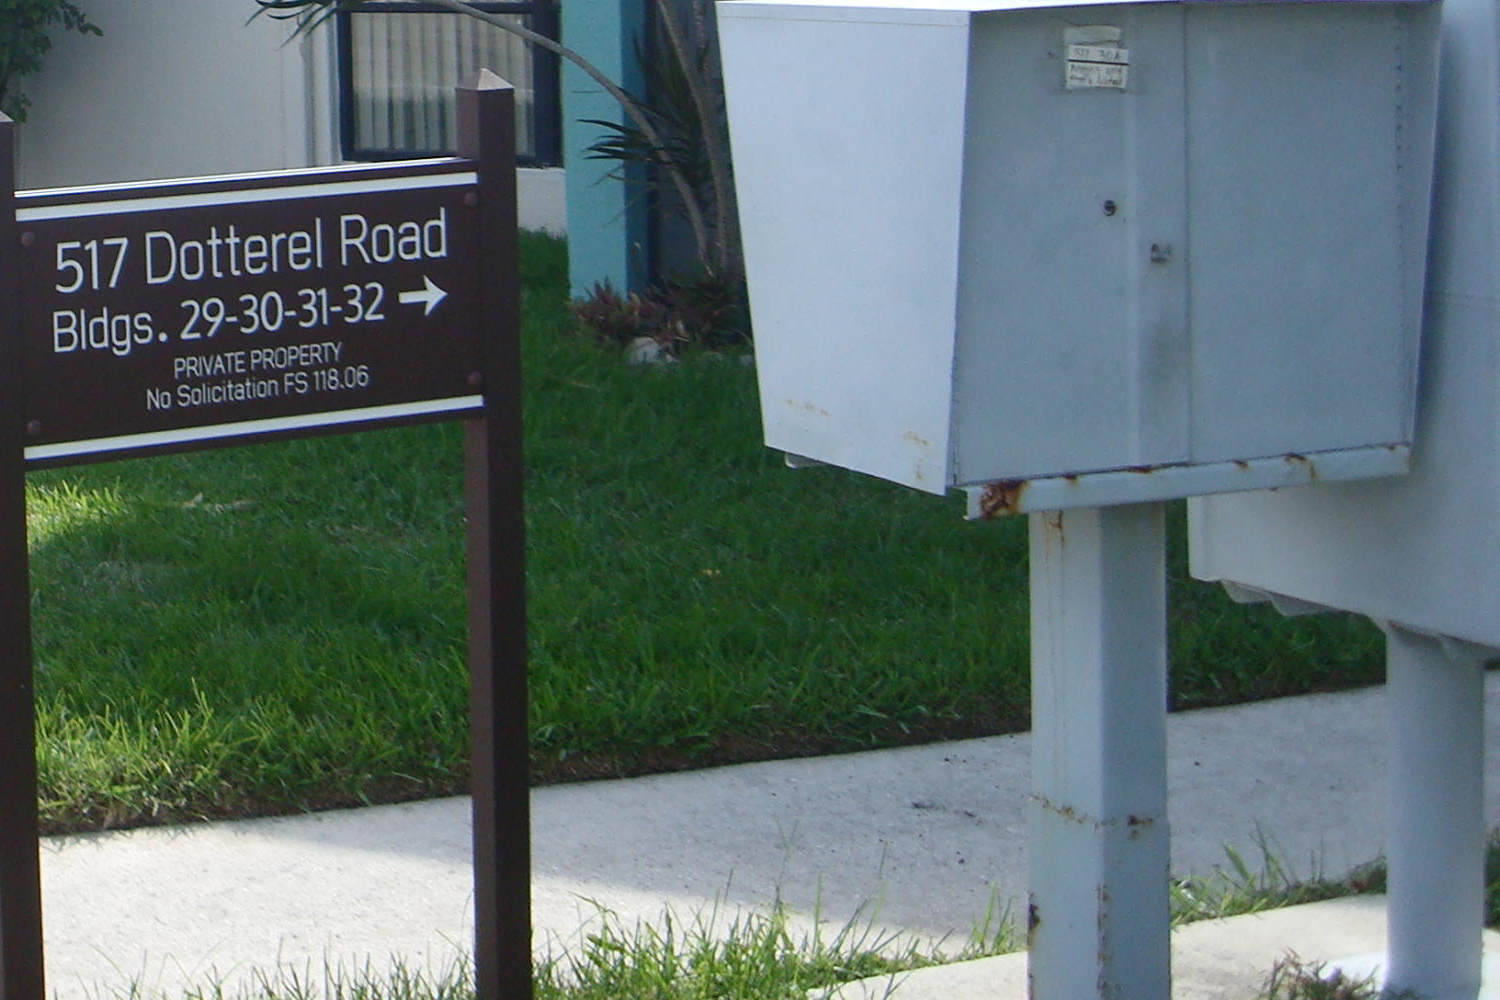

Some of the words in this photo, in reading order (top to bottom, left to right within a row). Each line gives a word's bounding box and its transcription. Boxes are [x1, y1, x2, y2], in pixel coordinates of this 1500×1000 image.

[55, 236, 128, 293] 517
[145, 217, 324, 284] Dotterel
[340, 206, 448, 266] Road
[53, 306, 168, 356] Bldgs.
[180, 281, 386, 340] 29-30-31-32
[146, 388, 172, 411] No
[177, 376, 279, 408] Solicitation
[284, 371, 310, 395] FS
[313, 365, 370, 392] 118.06
[174, 351, 246, 380] PRIVATE
[251, 341, 343, 370] PROPERTY
